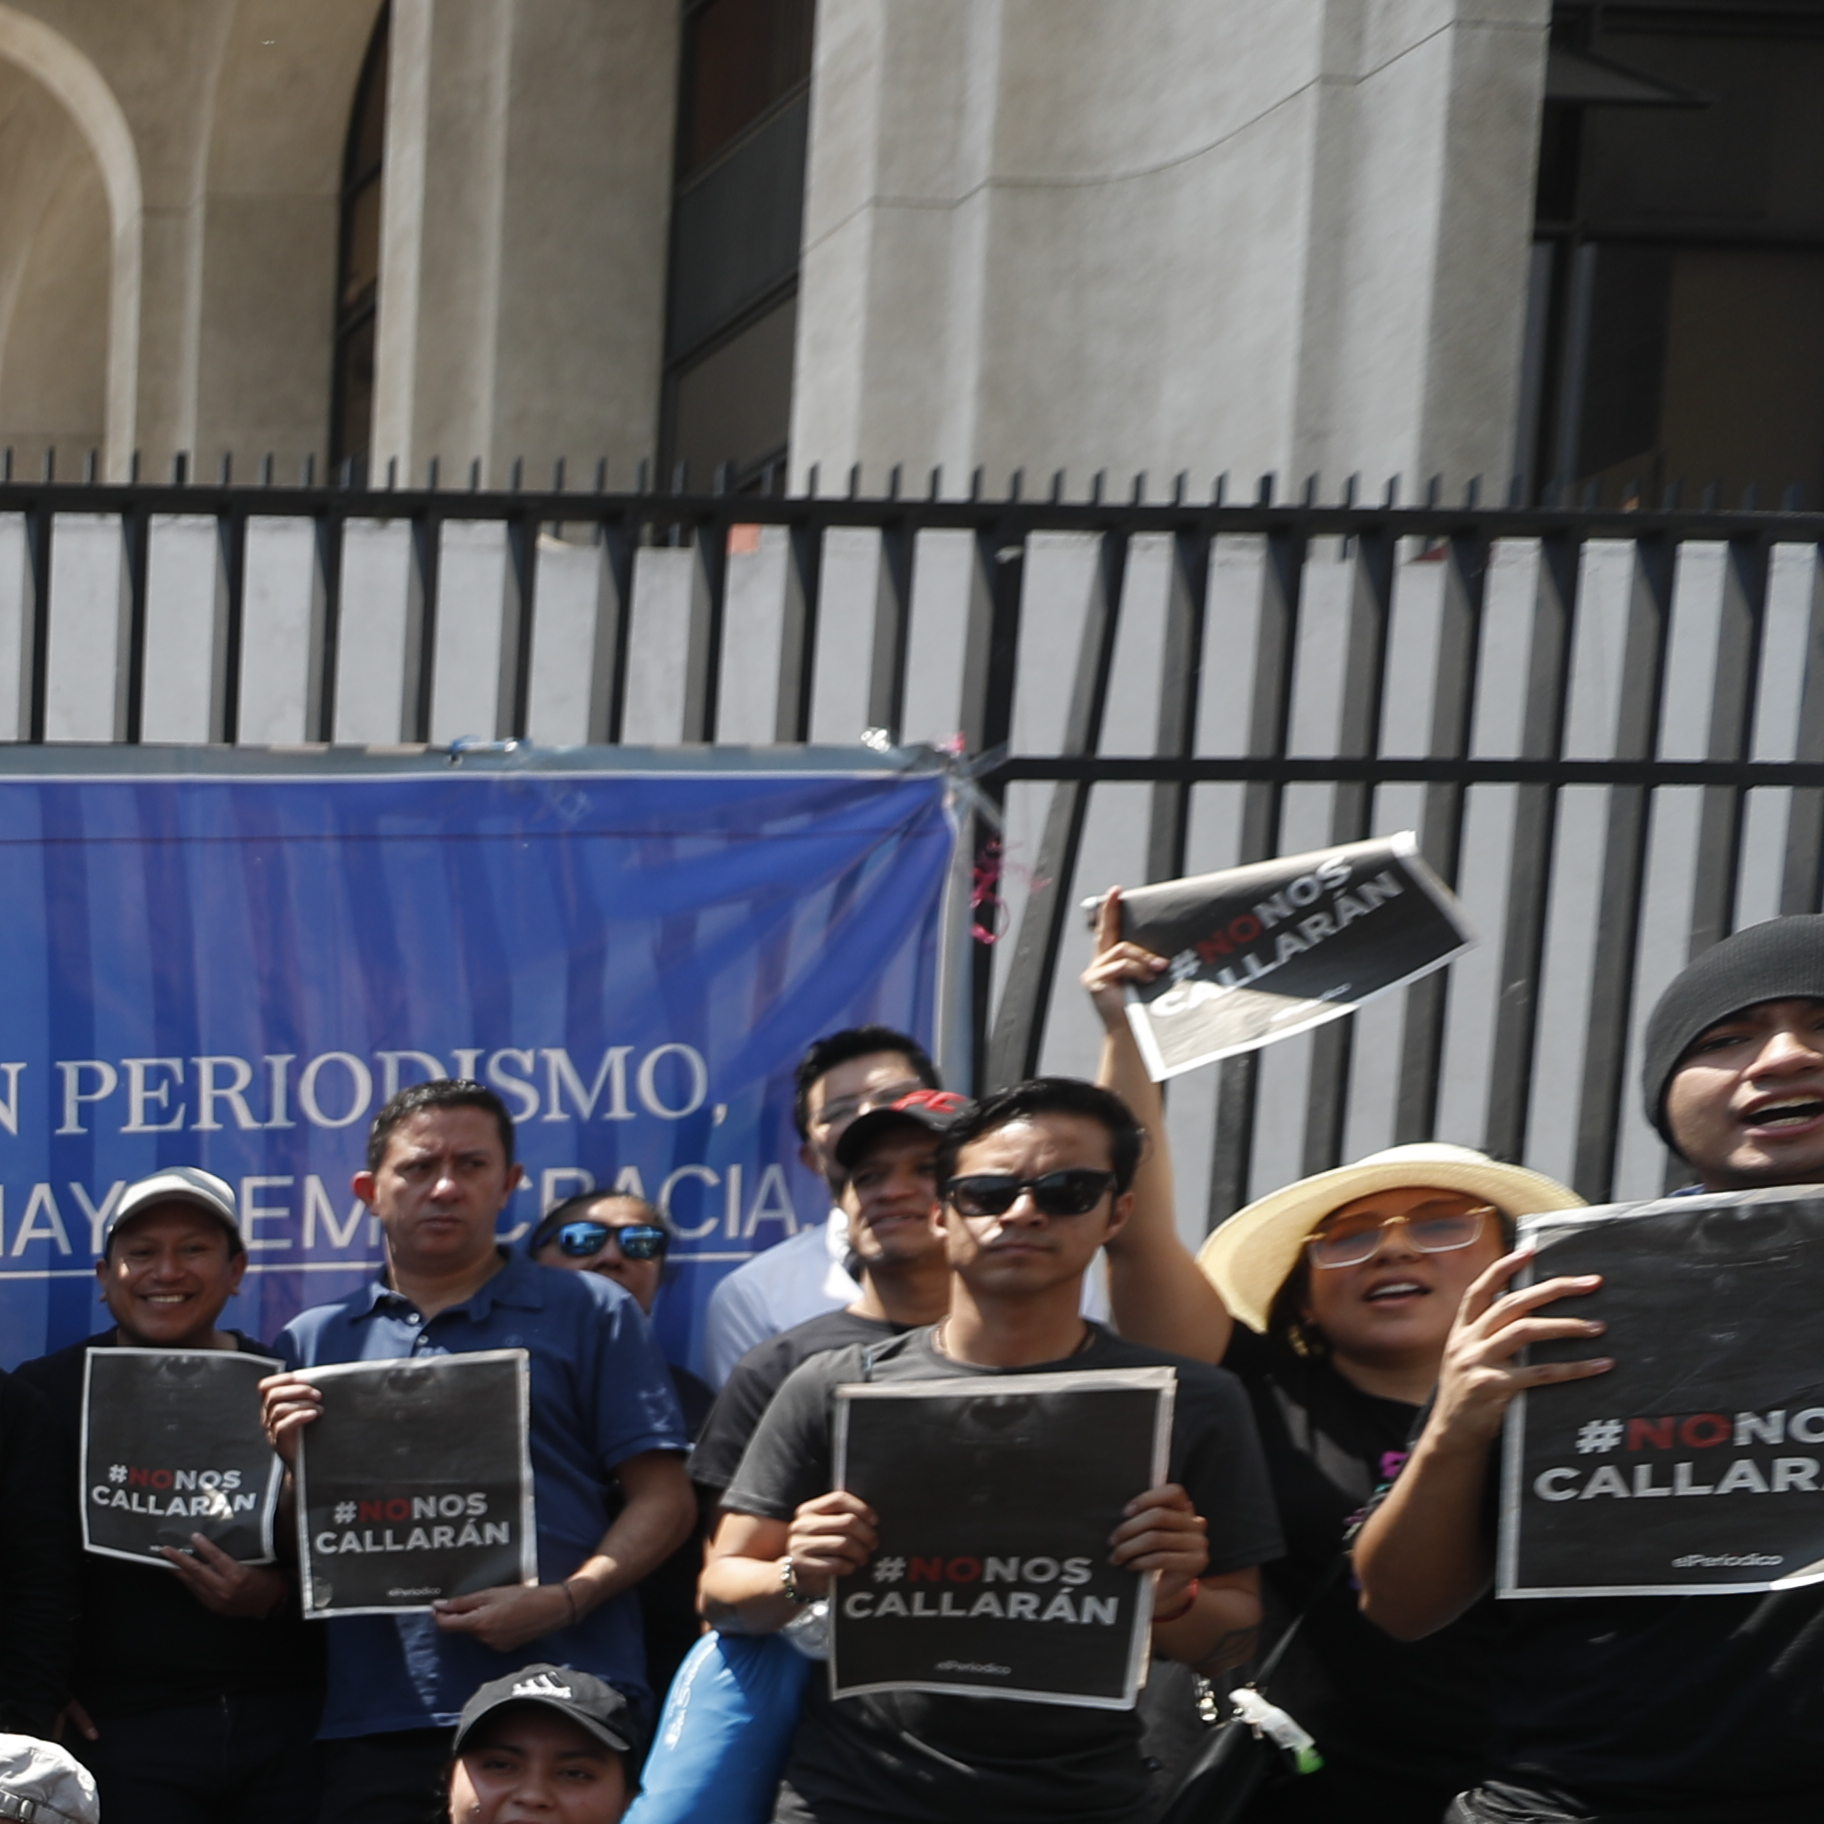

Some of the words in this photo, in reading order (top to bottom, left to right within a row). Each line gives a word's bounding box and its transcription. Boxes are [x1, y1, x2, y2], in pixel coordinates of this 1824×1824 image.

[1171, 857, 1352, 983] #NONOS
[1151, 871, 1404, 1018] CALLARÁN
[109, 1464, 242, 1491] #NONOS
[92, 1485, 257, 1519] CALLARÁN
[334, 1493, 488, 1525] #NONOS
[316, 1521, 510, 1555] CALLARÁN
[874, 1556, 1091, 1586] #NONOS
[1671, 1553, 1784, 1569] elPeriodico
[843, 1588, 1120, 1627] CALLARÁN
